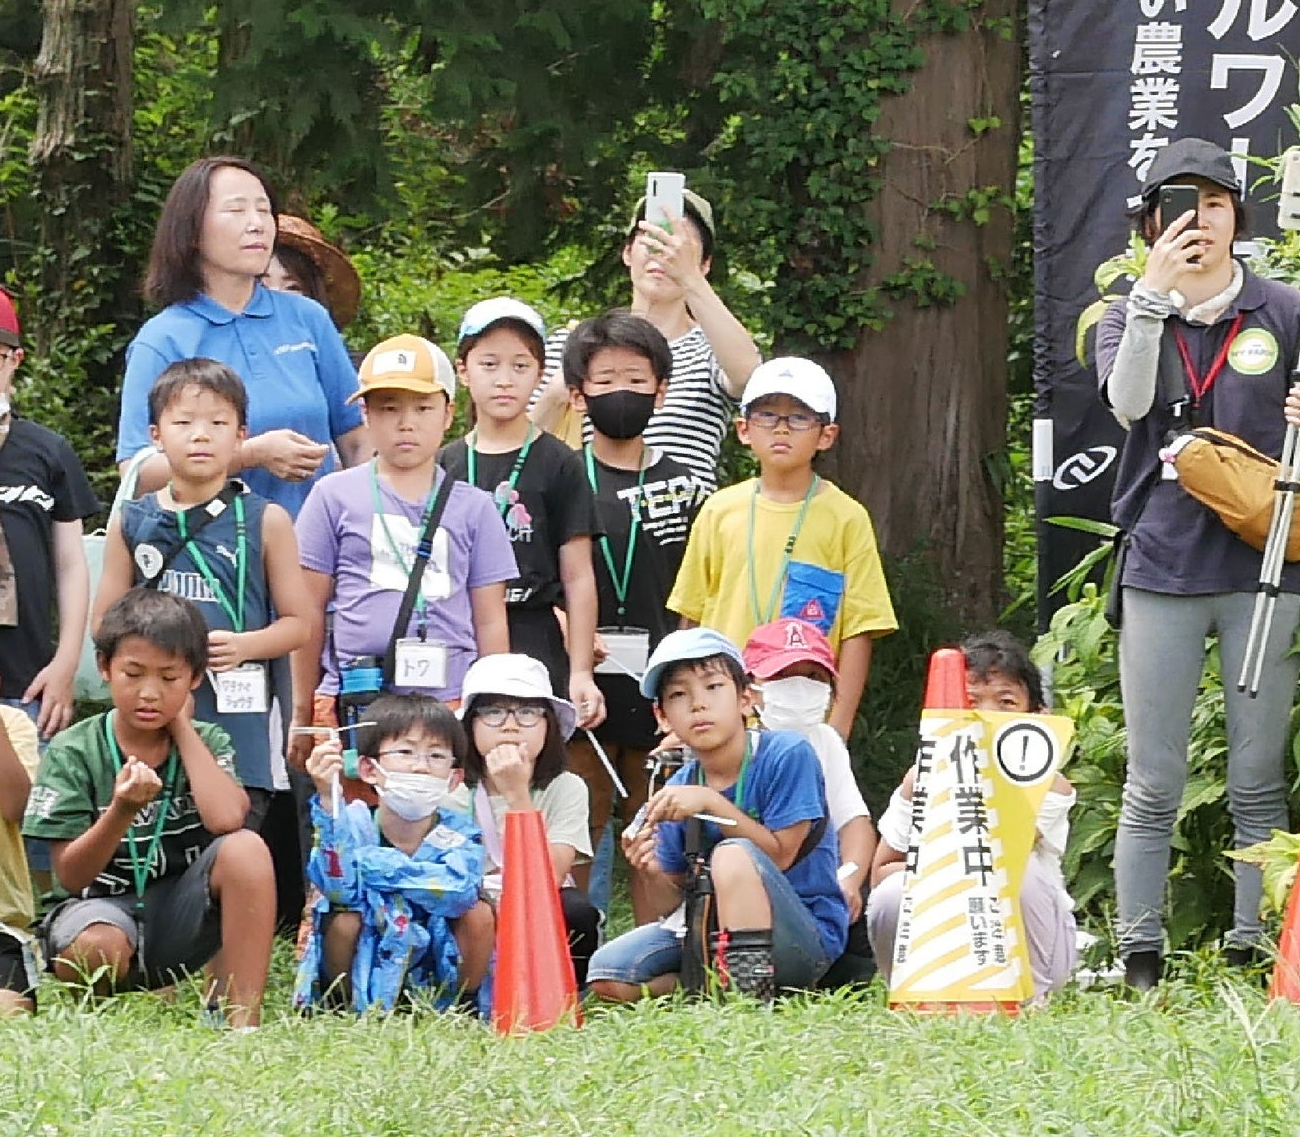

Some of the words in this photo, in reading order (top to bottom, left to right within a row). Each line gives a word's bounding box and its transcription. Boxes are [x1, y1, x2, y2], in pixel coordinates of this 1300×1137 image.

[404, 658, 430, 678] トワ
[950, 734, 995, 887] 作業中
